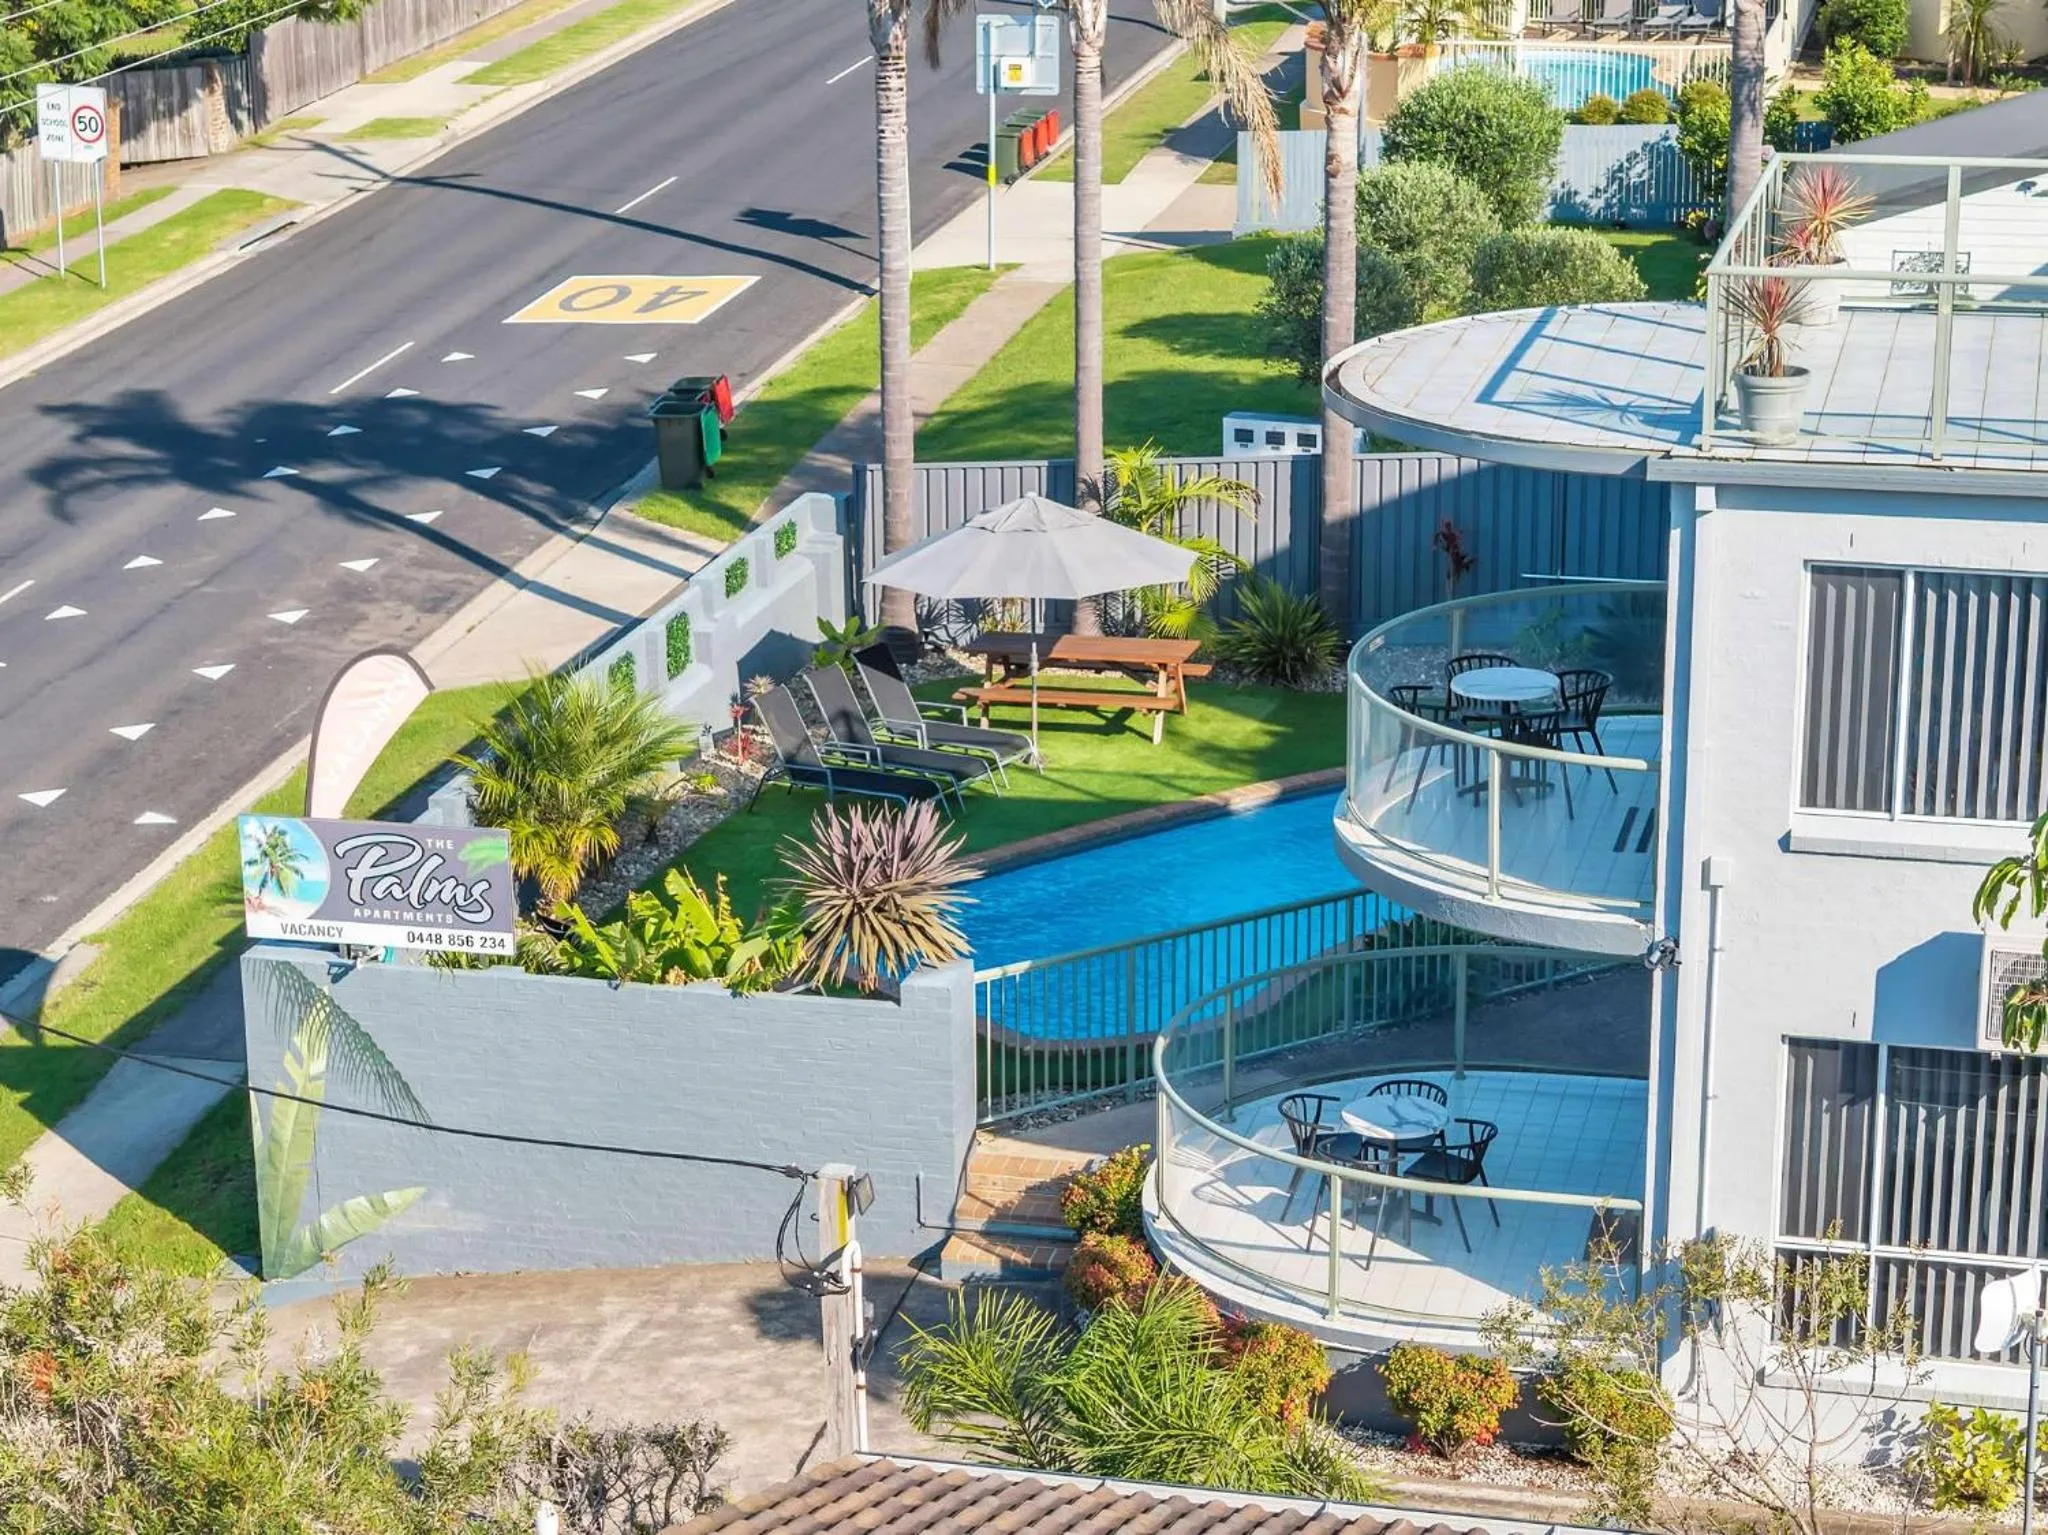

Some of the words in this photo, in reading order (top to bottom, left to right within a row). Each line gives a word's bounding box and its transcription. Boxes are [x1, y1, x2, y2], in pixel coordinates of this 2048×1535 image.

[77, 116, 99, 133] 50
[558, 284, 709, 314] 40
[426, 838, 455, 850] THE
[334, 833, 493, 923] Palms
[353, 907, 454, 924] APARTMENTS
[280, 922, 344, 938] VACANCY
[407, 930, 443, 945] 0448
[448, 933, 474, 947] 856
[479, 936, 505, 950] 234
